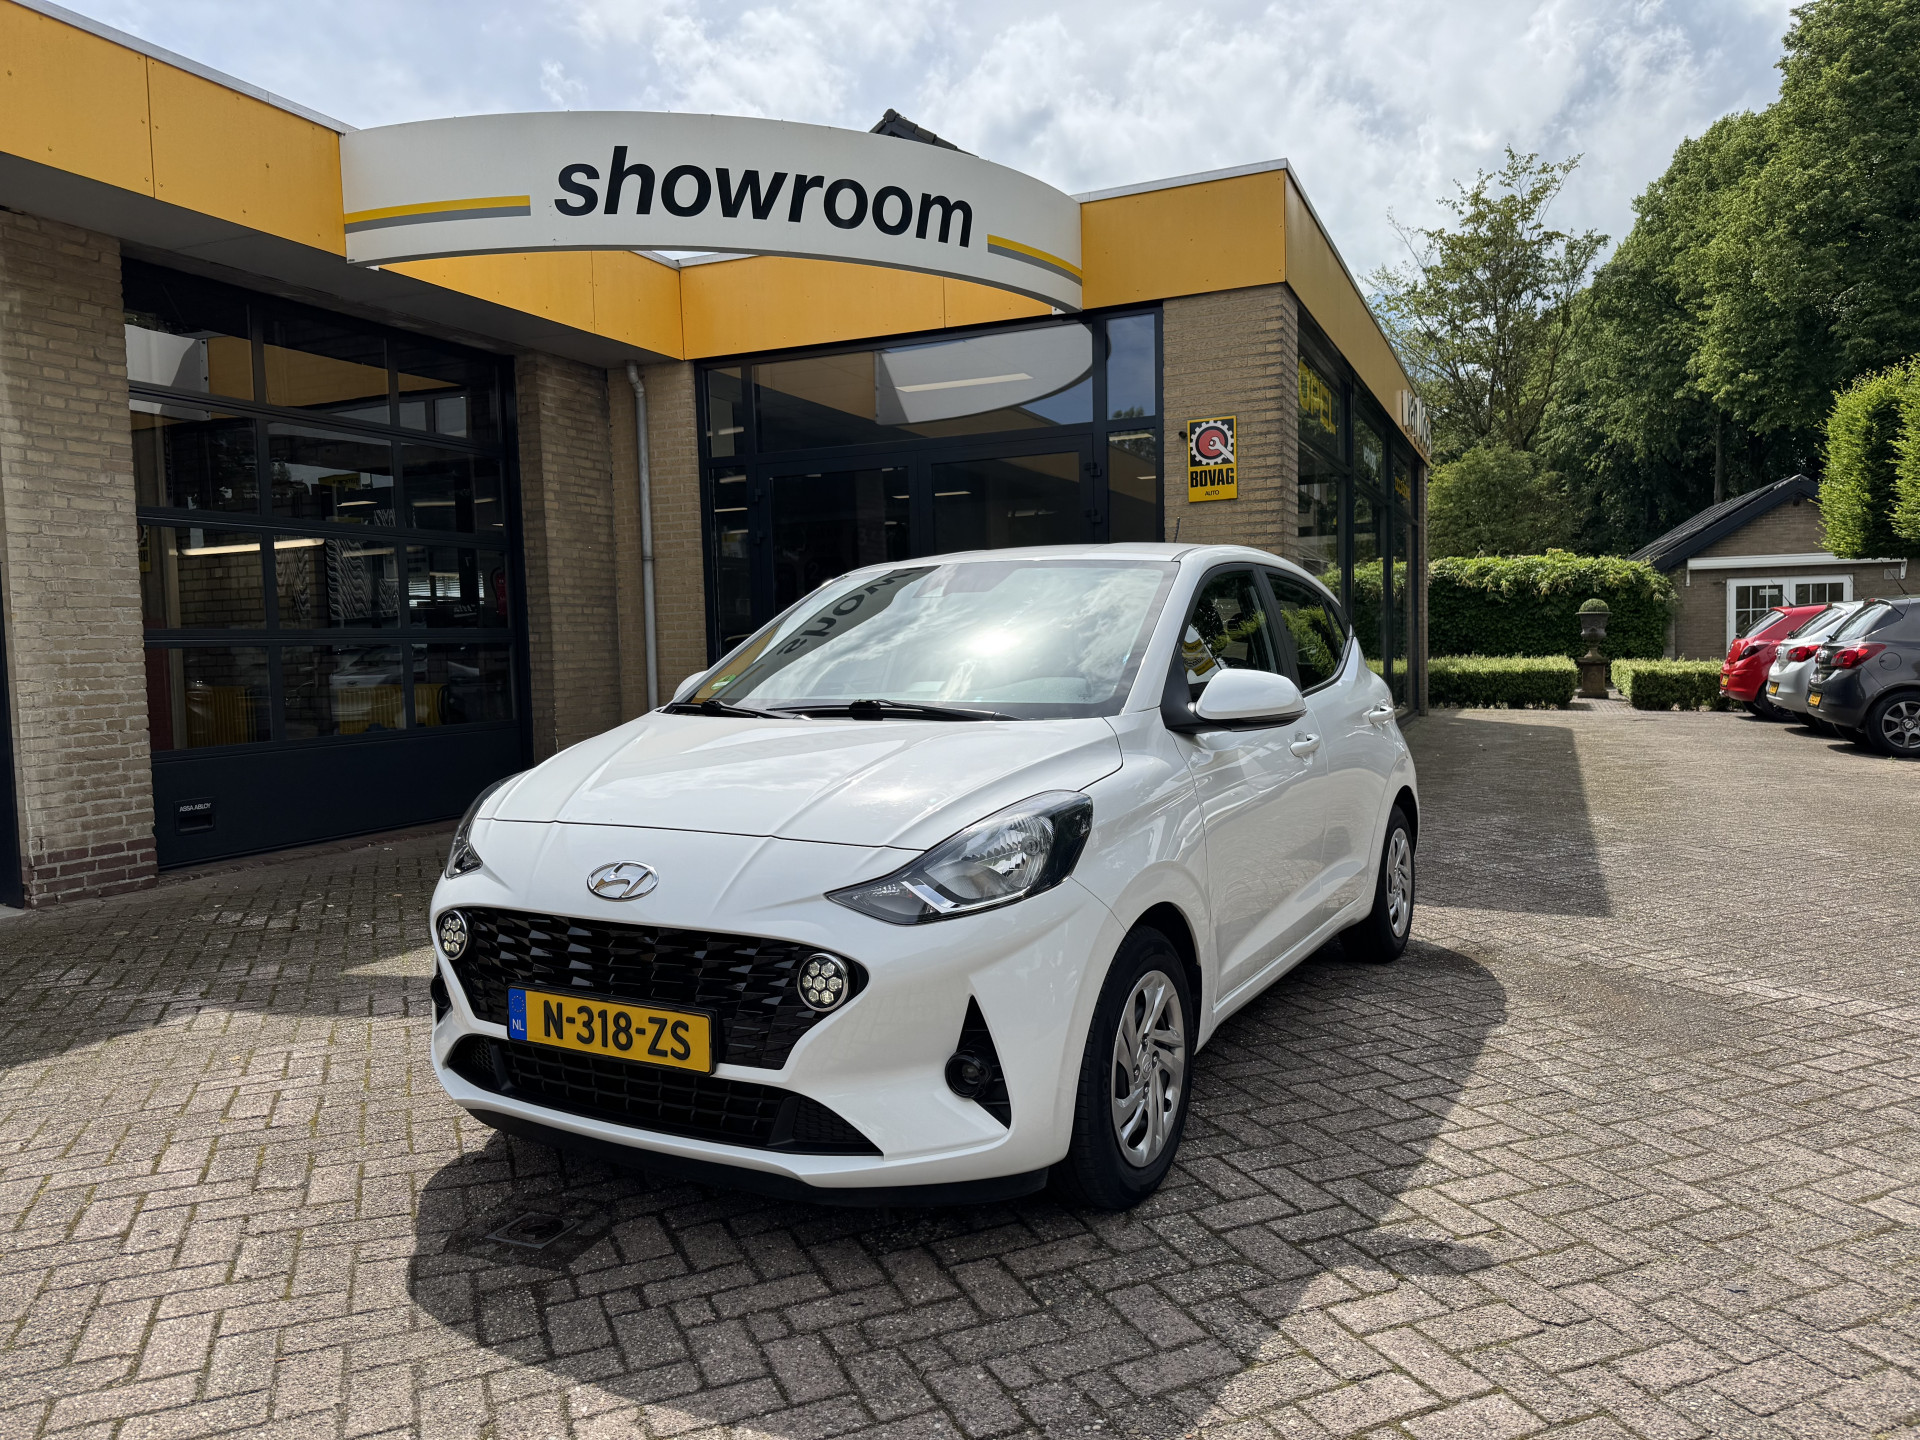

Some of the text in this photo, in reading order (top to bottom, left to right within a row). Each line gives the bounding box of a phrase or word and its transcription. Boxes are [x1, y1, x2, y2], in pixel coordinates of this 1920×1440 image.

[554, 145, 973, 248] showroom
[1298, 360, 1337, 435] OPEL
[1190, 467, 1235, 488] BOVAG
[512, 1018, 525, 1031] NL
[543, 999, 691, 1061] N-318-ZS
